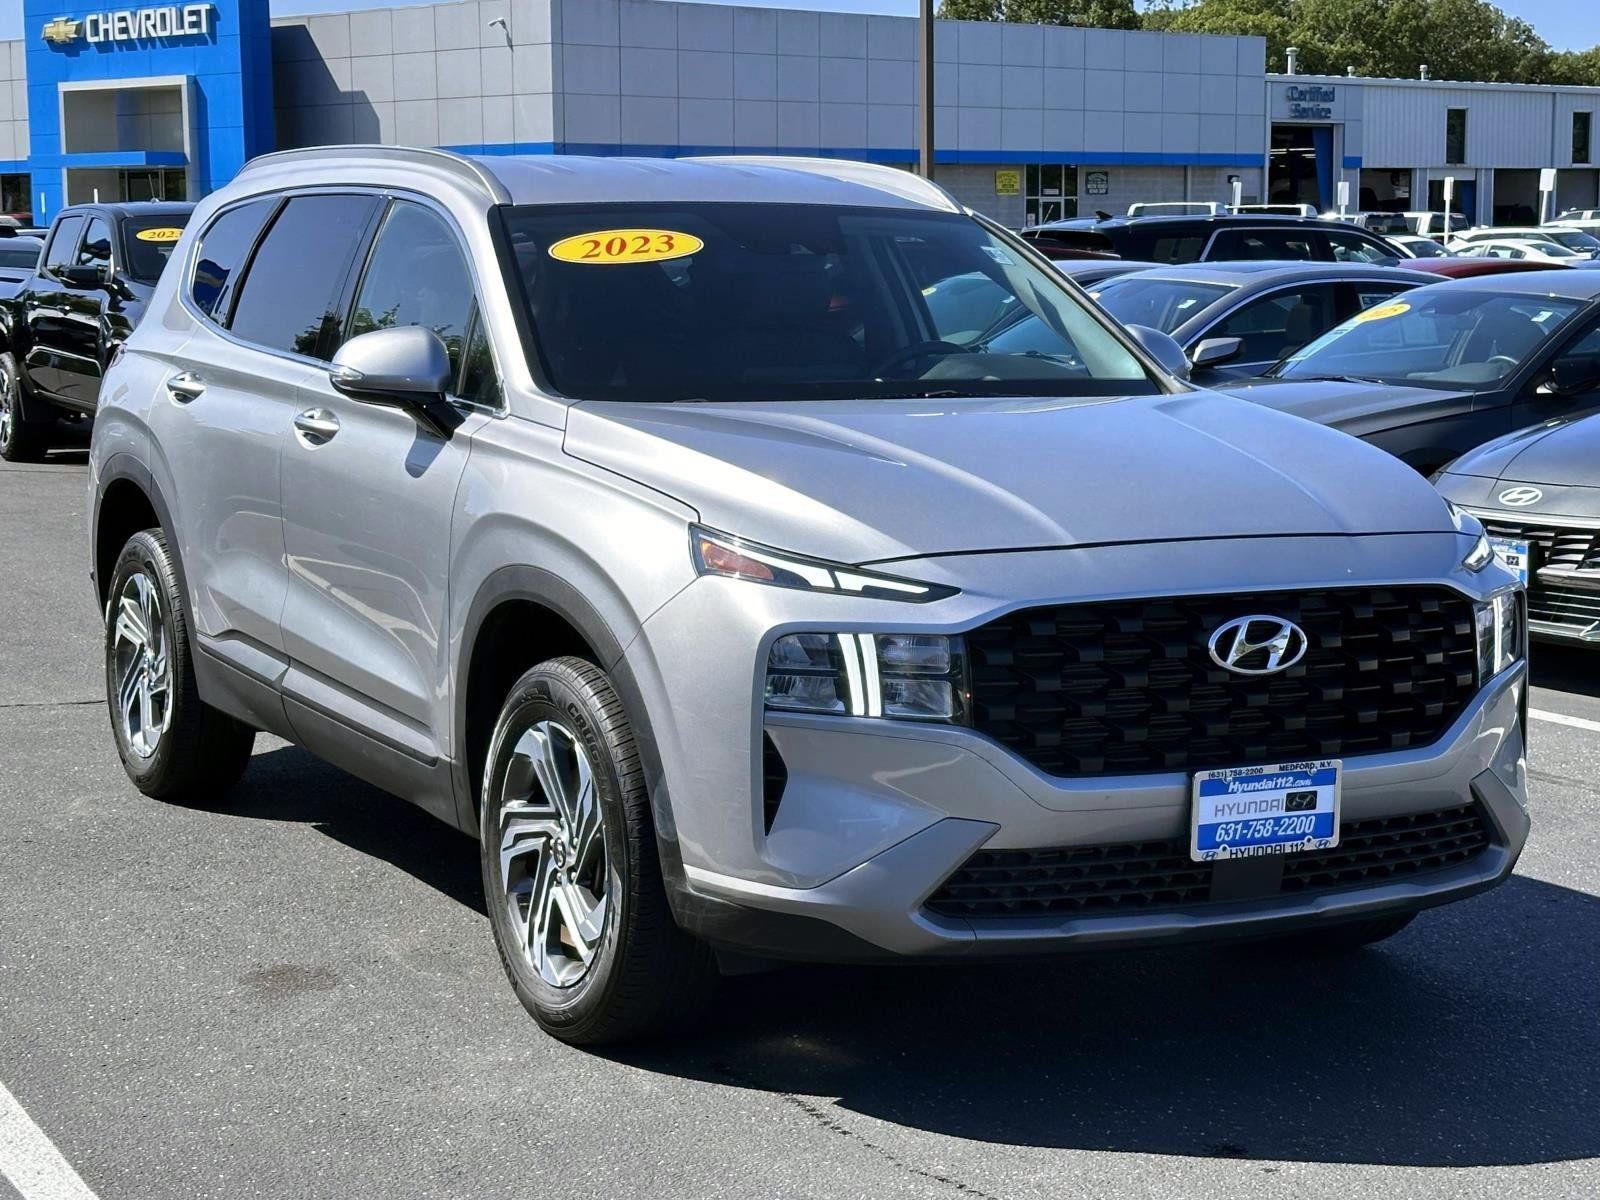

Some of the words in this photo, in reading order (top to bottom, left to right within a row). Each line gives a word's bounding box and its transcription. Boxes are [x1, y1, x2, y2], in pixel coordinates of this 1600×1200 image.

[86, 4, 211, 43] CHEVROLET
[581, 234, 675, 259] 2023
[1229, 767, 1264, 777] 758-2200
[1215, 798, 1285, 817] HYUNDAI
[1215, 815, 1316, 842] 631-758-2200
[1229, 843, 1286, 859] HYUNDAI
[1287, 842, 1305, 853] 112
